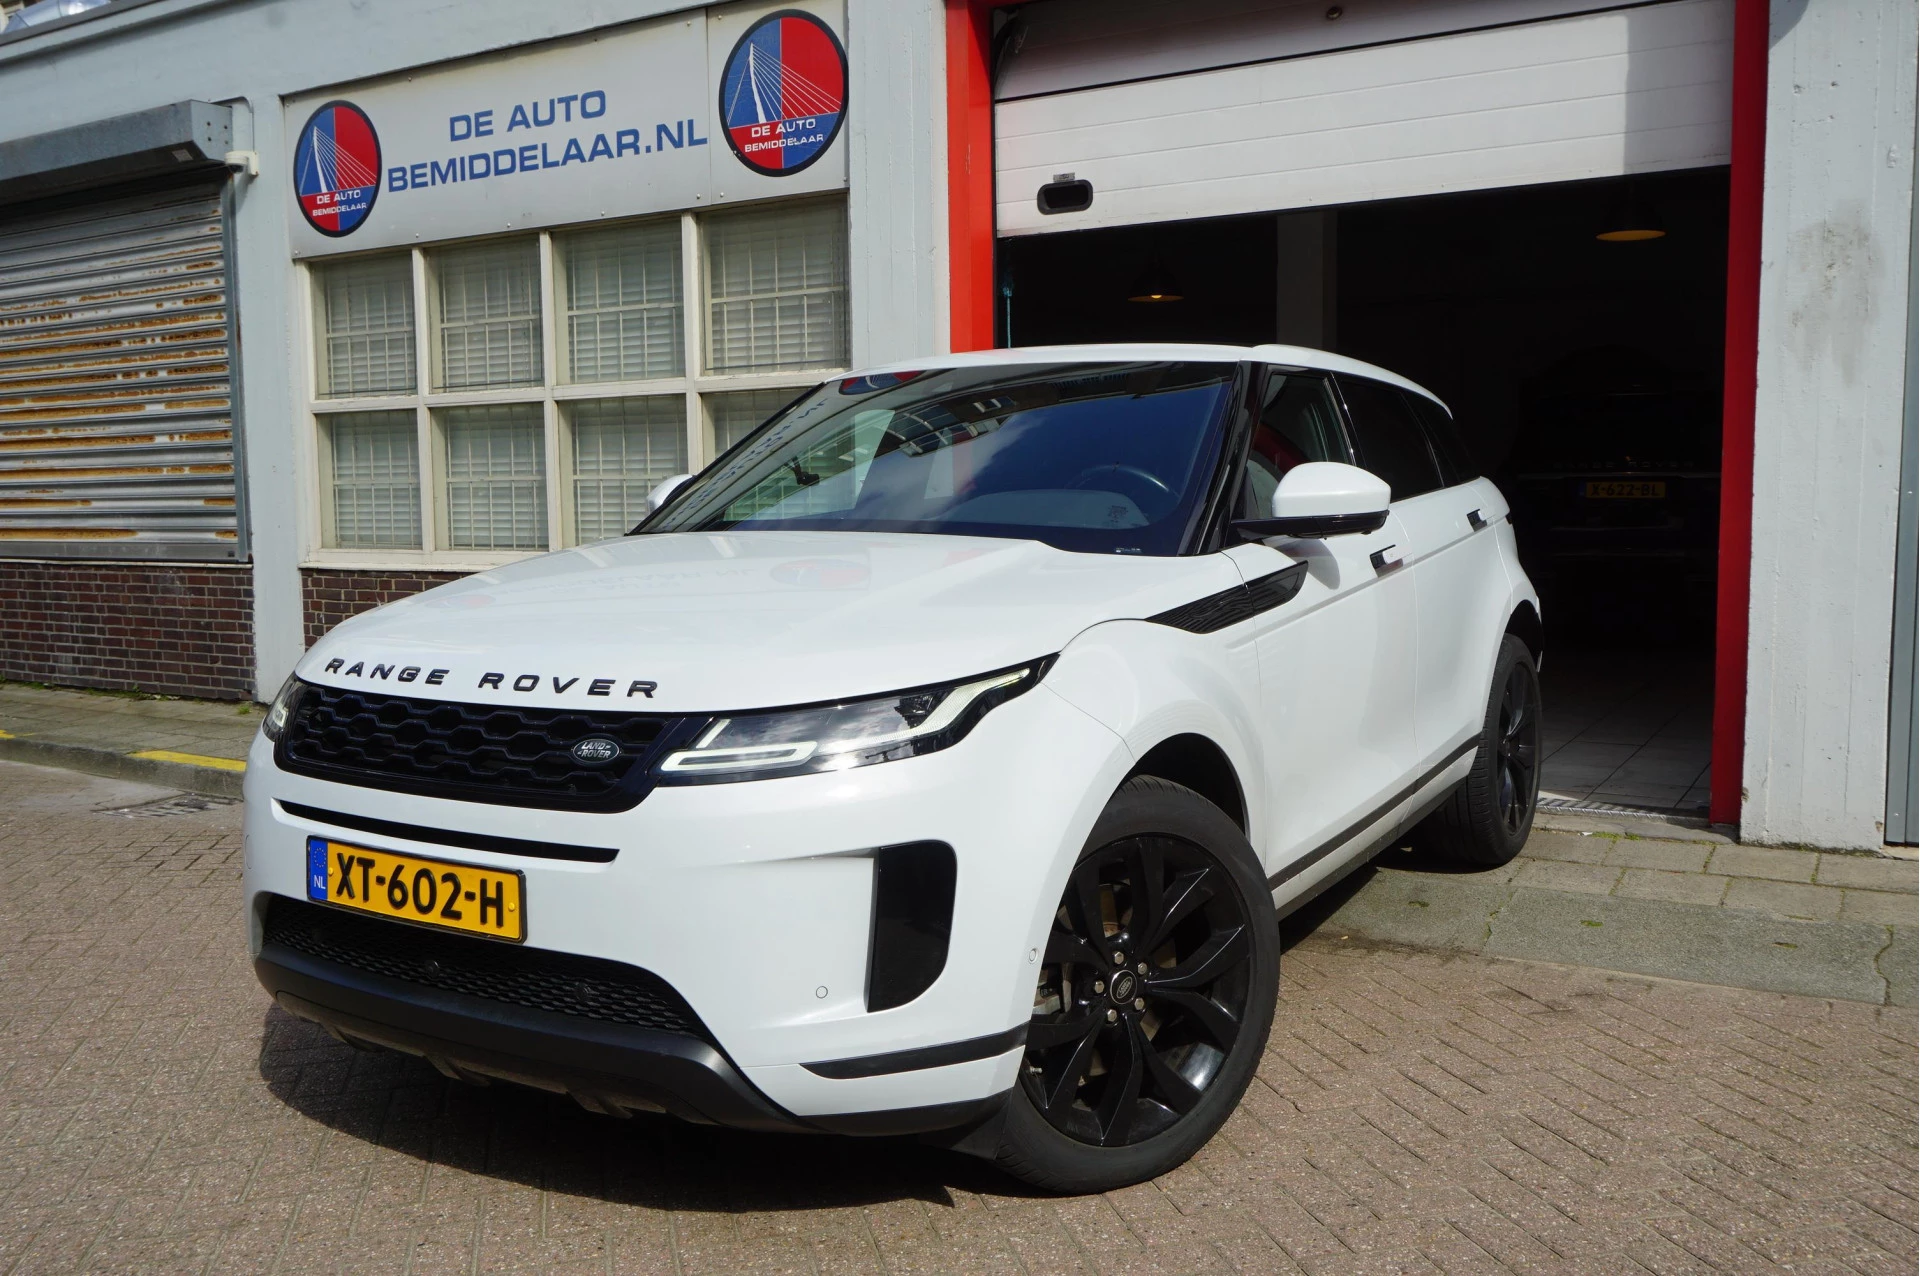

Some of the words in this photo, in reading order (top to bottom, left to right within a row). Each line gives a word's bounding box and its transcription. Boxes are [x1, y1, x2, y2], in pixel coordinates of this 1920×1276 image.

[450, 109, 494, 142] DE
[507, 89, 606, 132] AUTO
[752, 125, 771, 138] DE
[775, 118, 816, 134] AUTO
[744, 133, 824, 153] BEMIDDELAAR
[387, 118, 708, 193] BEMIDDELAAR.NL
[316, 194, 331, 205] DE
[333, 189, 361, 201] AUTO
[312, 202, 367, 217] BEMIDDELAAR
[1590, 483, 1661, 497] X-622-BL
[324, 657, 450, 686] RANGE
[477, 672, 659, 699] ROVER
[313, 874, 326, 890] NL
[336, 852, 504, 929] XT-602-H
